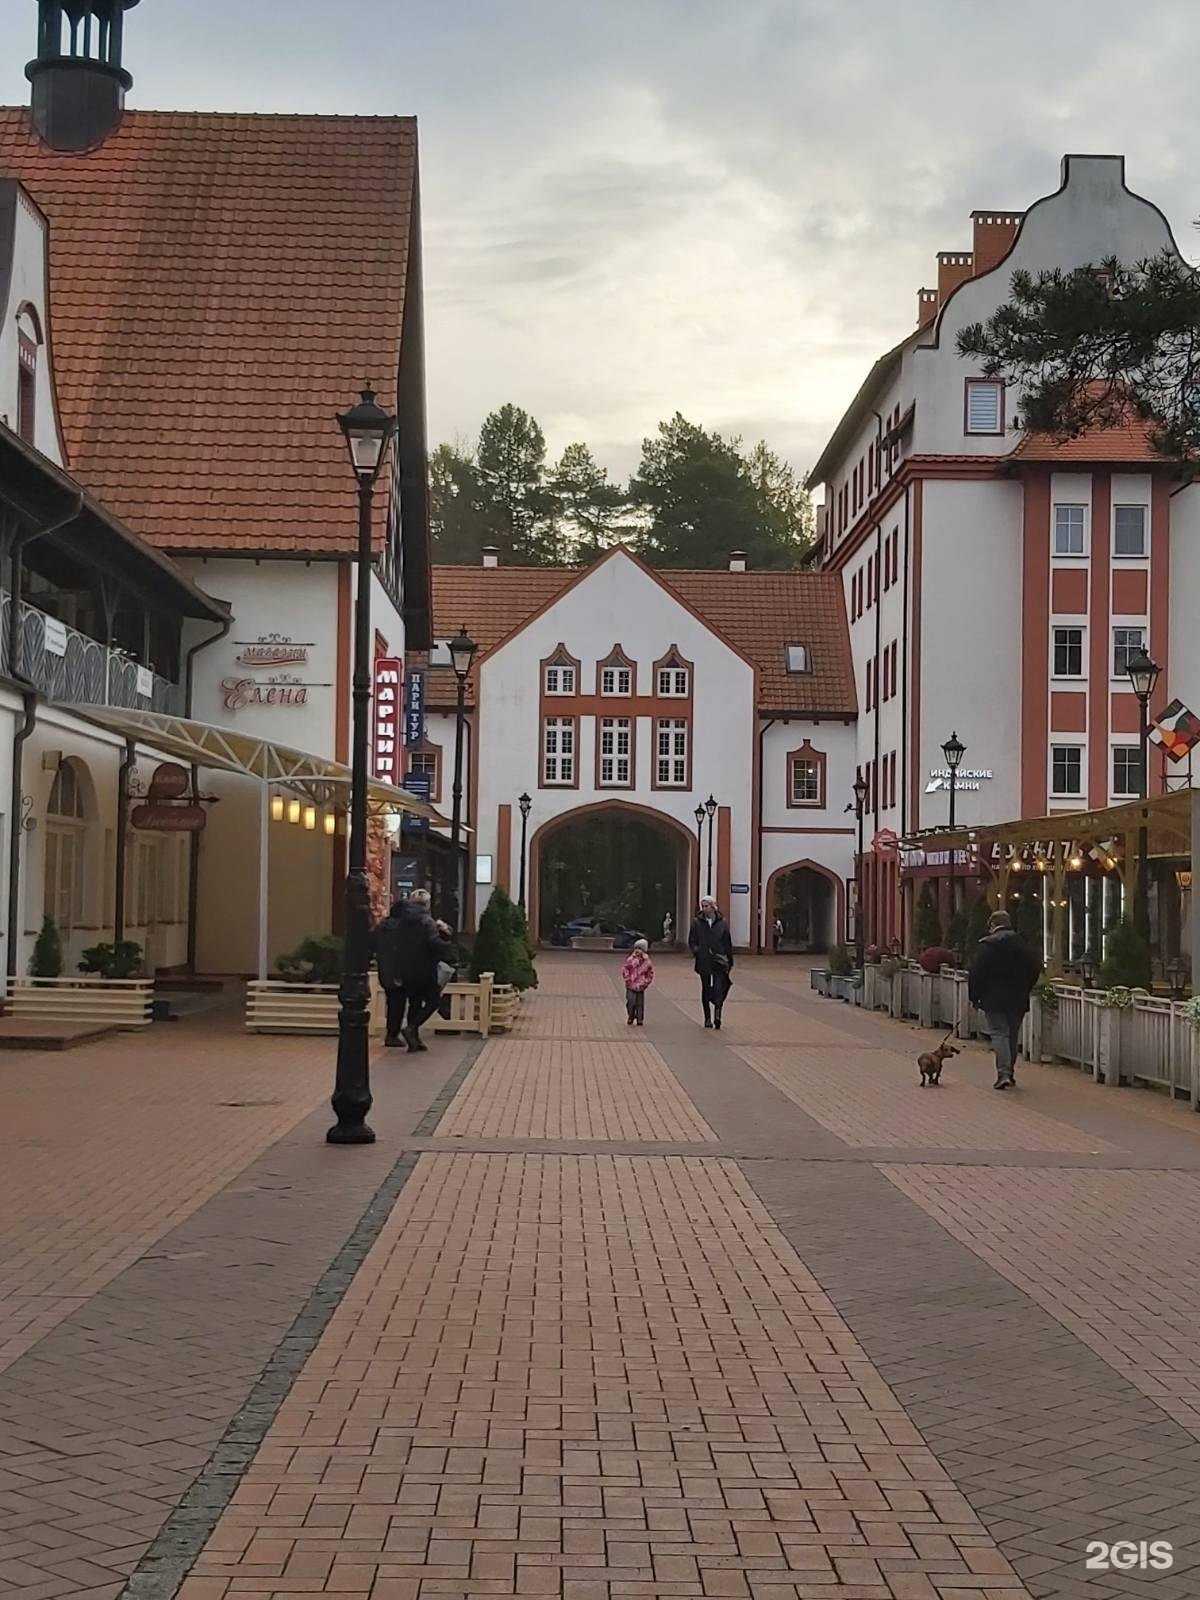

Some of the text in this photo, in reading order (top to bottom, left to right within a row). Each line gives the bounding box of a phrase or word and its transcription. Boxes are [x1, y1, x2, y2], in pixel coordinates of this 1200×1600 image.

[221, 678, 308, 710] Елена
[410, 674, 420, 740] ПАРИ ТУР
[943, 782, 980, 790] КМНИ
